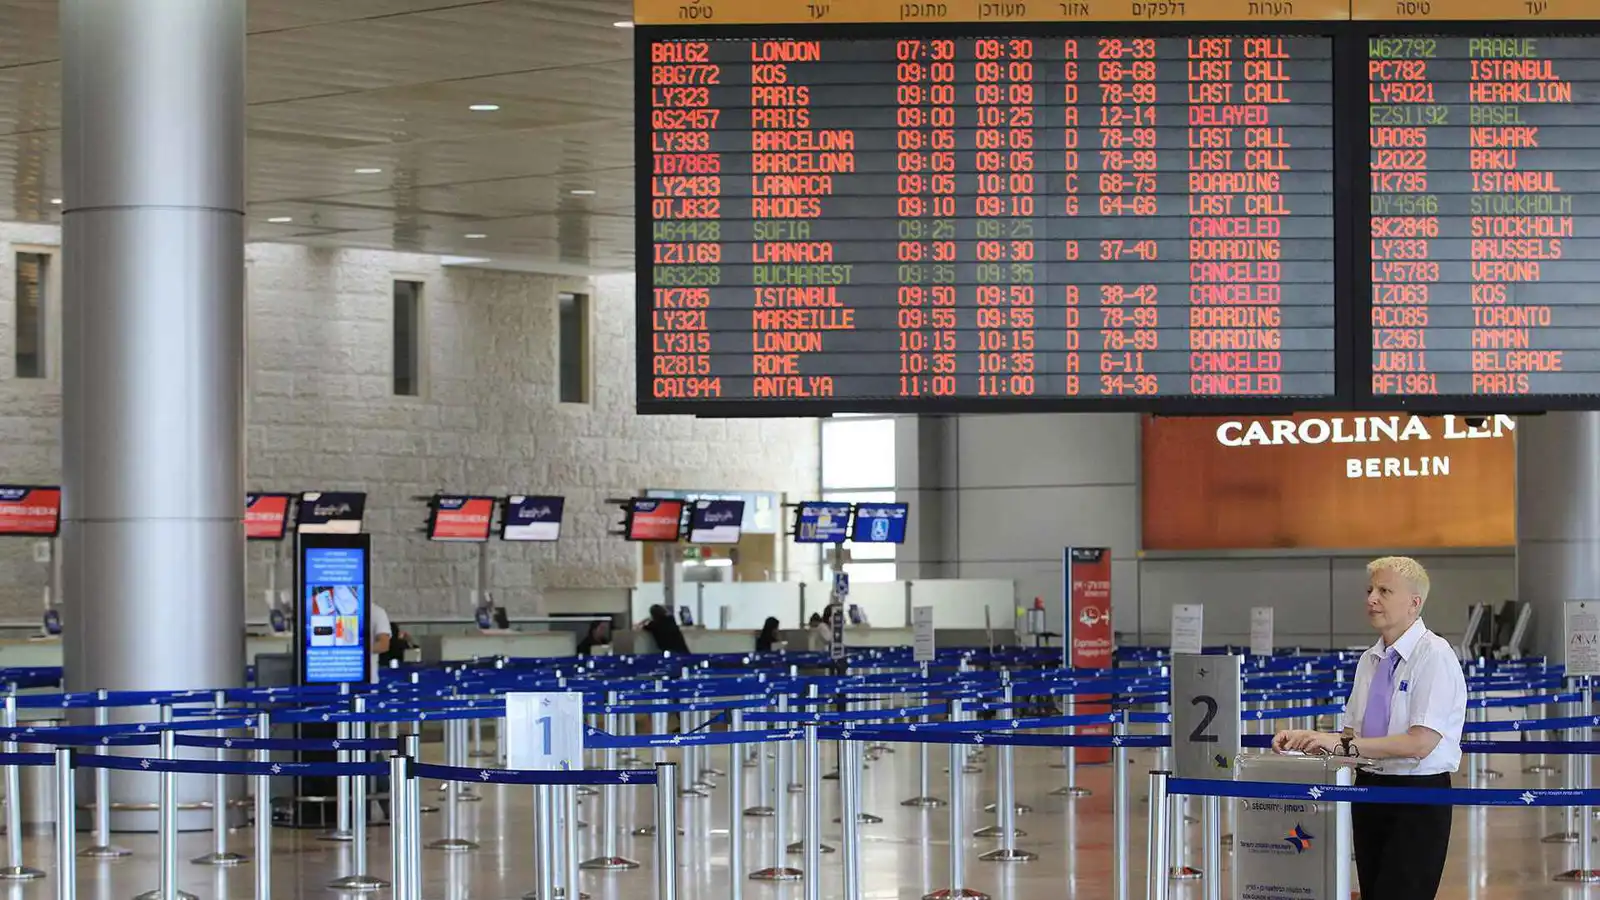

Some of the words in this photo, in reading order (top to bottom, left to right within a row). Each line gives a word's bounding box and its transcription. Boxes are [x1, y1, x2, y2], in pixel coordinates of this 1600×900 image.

[678, 5, 713, 19] טיסה
[806, 3, 830, 19] יעד
[900, 3, 947, 20] מתוכנן
[978, 3, 1026, 20] מעודכן
[1059, 3, 1089, 17] אזור
[1132, 0, 1186, 19] דלפקים
[1248, 1, 1293, 16] הערות
[1396, 2, 1431, 15] טיסה
[1525, 2, 1548, 15] יעד
[651, 42, 709, 63] BA162
[751, 40, 821, 62] LONDON
[896, 40, 955, 62] 07:30
[975, 39, 1033, 60] 09:30
[1065, 40, 1078, 58] A
[1097, 39, 1156, 59] 28-33
[1188, 38, 1231, 59] LAST
[1244, 38, 1289, 58] CALL
[1367, 38, 1437, 59] W62792
[1469, 38, 1538, 59] PRAGUE
[651, 64, 719, 85] BBG772
[752, 62, 787, 85] KOS
[897, 62, 955, 82] 09:00
[975, 61, 1033, 84] 09:00
[1065, 61, 1078, 81] G
[1097, 61, 1156, 83] G6-G8
[1188, 60, 1232, 83] LAST
[1244, 61, 1290, 83] CALL
[1368, 60, 1428, 80] PC782
[1472, 59, 1559, 81] ISTANBUL
[652, 85, 710, 108] LY323
[751, 85, 810, 107] PARIS
[897, 84, 955, 107] 09:00
[975, 84, 1034, 104] 09:09
[1066, 83, 1078, 103] D
[1101, 83, 1158, 105] 78-99
[1188, 82, 1232, 105] LAST
[1244, 82, 1291, 105] CALL
[1369, 82, 1436, 103] LY5021
[1469, 81, 1572, 102] HERAKLION
[651, 108, 720, 130] QS2457
[751, 107, 811, 129] PARIS
[896, 106, 955, 129] 09:00
[978, 106, 1034, 128] 10:25
[1065, 106, 1078, 125] A
[1100, 105, 1156, 126] 12-14
[1188, 105, 1269, 127] DELAYED
[1470, 103, 1525, 126] BASEL
[651, 130, 709, 152] LY393
[752, 129, 854, 152] BARCELONA
[897, 129, 955, 150] 09:05
[976, 128, 1035, 151] 09:05
[1065, 128, 1078, 149] D
[1100, 128, 1156, 148] 78-99
[1188, 127, 1232, 150] LAST
[1245, 127, 1289, 150] CALL
[1471, 127, 1539, 147] NEWARK
[751, 152, 855, 174] BARCELONA
[897, 151, 955, 174] 09:05
[976, 151, 1034, 171] 09:05
[1066, 150, 1079, 171] D
[1102, 150, 1158, 173] 78-99
[1189, 149, 1231, 172] LAST
[1244, 149, 1288, 172] CALL
[1470, 149, 1518, 169] BAKU
[651, 175, 720, 196] LY2433
[752, 174, 832, 196] LARNACA
[897, 173, 955, 196] 09:05
[978, 173, 1034, 195] 10:00
[1066, 174, 1077, 194] C
[1099, 172, 1157, 195] 68-75
[1189, 172, 1280, 192] BOARDING
[1371, 172, 1428, 191] TK795
[1473, 171, 1559, 192] ISTANBUL
[752, 197, 823, 218] RHODES
[898, 196, 955, 216] 09:10
[976, 196, 1033, 216] 09:10
[1066, 196, 1079, 215] G
[1099, 195, 1157, 214] G4-G6
[1190, 195, 1233, 217] LAST
[1245, 194, 1289, 217] CALL
[753, 219, 812, 241] SOFIA
[1189, 217, 1280, 238] CANCELED
[1370, 216, 1440, 238] SK2846
[1472, 216, 1573, 238] STOCKHOLM
[752, 241, 833, 263] LARNACA
[897, 241, 956, 261] 09:30
[977, 240, 1034, 261] 09:30
[1066, 241, 1079, 260] B
[1102, 240, 1157, 260] 37-40
[1189, 240, 1280, 261] BOARDING
[1371, 240, 1428, 258] LY333
[1472, 237, 1561, 260] BRUSSELS
[753, 264, 850, 286] BUCHAREST
[1190, 261, 1280, 283] CANCELED
[1371, 262, 1439, 282] LY5783
[1472, 260, 1540, 282] VERONA
[654, 287, 710, 307] TK785
[755, 286, 845, 308] ISTANBUL
[898, 285, 956, 306] 09:50
[976, 285, 1034, 307] 09:50
[1066, 285, 1079, 307] B
[1102, 285, 1157, 307] 38-42
[1189, 284, 1280, 305] CANCELED
[1473, 283, 1507, 304] KOS
[652, 309, 707, 331] LY321
[752, 308, 854, 331] MARSEILLE
[898, 308, 956, 330] 09:55
[977, 307, 1035, 328] 09:55
[1066, 307, 1079, 327] D
[1103, 307, 1158, 329] 78-99
[1190, 306, 1280, 328] BOARDING
[1475, 306, 1551, 327] TORONTO
[653, 331, 710, 353] LY315
[753, 331, 822, 353] LONDON
[900, 330, 956, 352] 10:15
[980, 330, 1034, 352] 10:15
[1067, 330, 1080, 350] D
[1101, 329, 1158, 351] 78-99
[1190, 328, 1280, 350] BOARDING
[1473, 328, 1529, 348] AMMAN
[653, 355, 710, 376] AZ815
[753, 353, 798, 375] ROME
[900, 352, 956, 374] 10:35
[980, 352, 1034, 374] 10:35
[1067, 352, 1079, 374] A
[1100, 351, 1143, 372] 6-11
[1189, 351, 1281, 372] CANCELED
[1473, 350, 1561, 371] BELGRADE
[753, 375, 833, 398] ANTALYA
[900, 376, 956, 396] 11:00
[979, 374, 1034, 396] 11:00
[1066, 375, 1079, 395] B
[1103, 374, 1158, 395] 34-36
[1189, 373, 1282, 394] CANCELED
[1473, 372, 1529, 394] PARIS
[1217, 414, 1431, 446] CAROLINA
[1346, 456, 1450, 478] BERLIN
[1189, 695, 1219, 742] 2
[535, 716, 552, 755] 1
[1252, 802, 1278, 812] SECURITY
